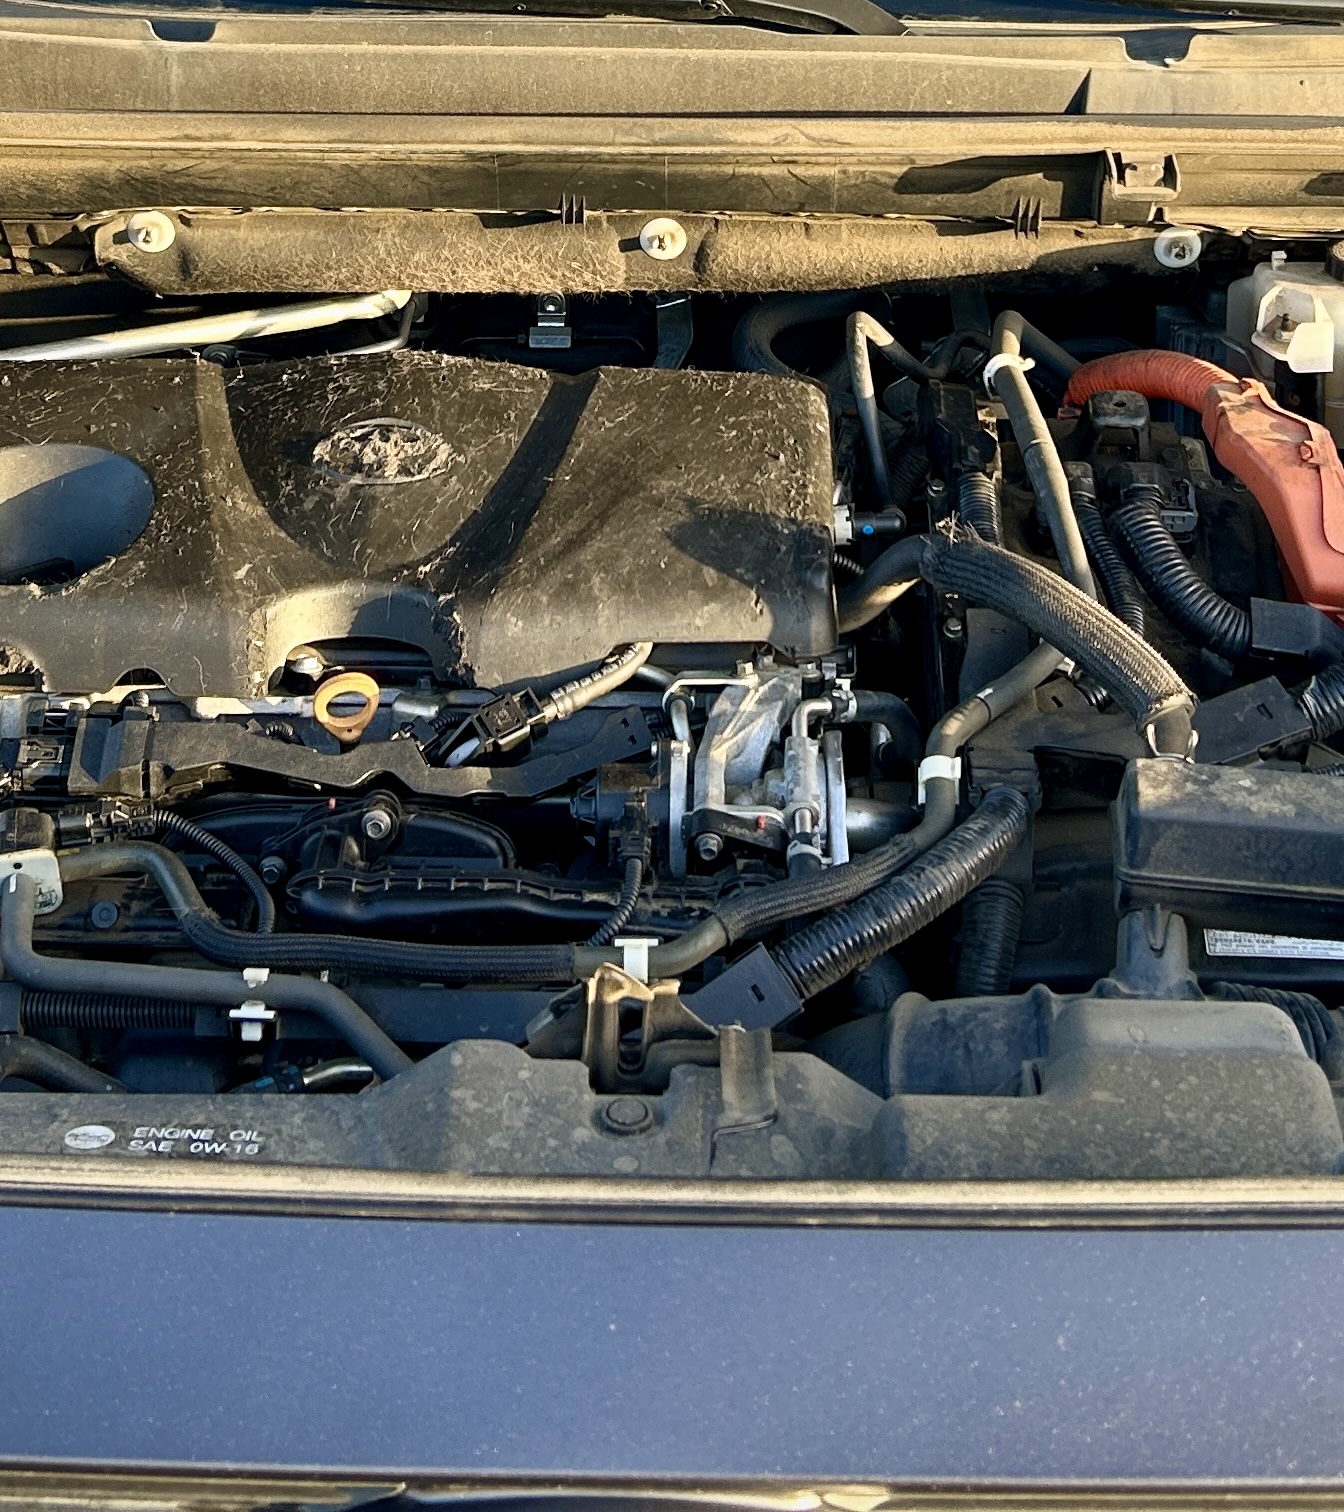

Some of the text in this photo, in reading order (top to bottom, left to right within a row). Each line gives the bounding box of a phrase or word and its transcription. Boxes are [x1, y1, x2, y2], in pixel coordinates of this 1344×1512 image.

[133, 1126, 266, 1142] ENGINE OIL
[127, 1140, 174, 1153] SAE
